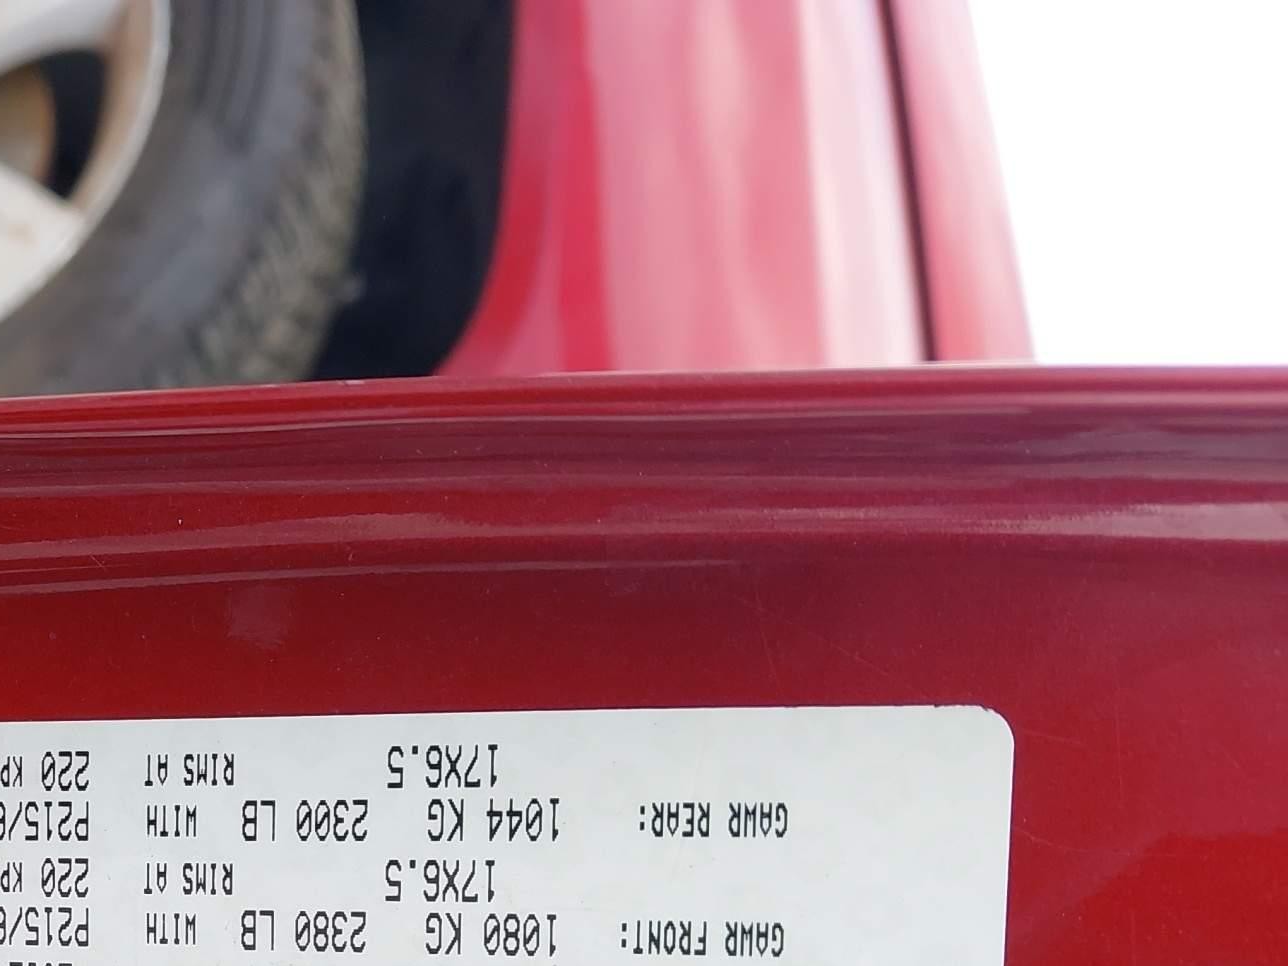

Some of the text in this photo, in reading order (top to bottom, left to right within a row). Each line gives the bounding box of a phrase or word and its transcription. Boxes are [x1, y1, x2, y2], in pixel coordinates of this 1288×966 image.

[42, 751, 89, 791] 220
[144, 754, 168, 786] AT
[184, 753, 234, 786] RIMS
[387, 744, 498, 788] 17X6.5
[147, 805, 197, 837] WITH
[242, 800, 275, 841] LB
[297, 800, 368, 841] 2300
[428, 799, 464, 841] KG
[486, 798, 559, 842] 1044
[640, 802, 710, 837] REAR:
[729, 802, 788, 838] GAWR
[41, 858, 88, 898] 220
[144, 863, 167, 894] AT
[183, 863, 233, 895] RIMS
[385, 860, 495, 902] 17X6.5
[147, 913, 196, 945] WITH
[241, 910, 274, 951] LB
[295, 911, 366, 953] 2380
[426, 913, 461, 955] KG
[484, 913, 556, 957] 1080
[621, 920, 707, 956] FRONT:
[725, 921, 784, 957] GAWR
